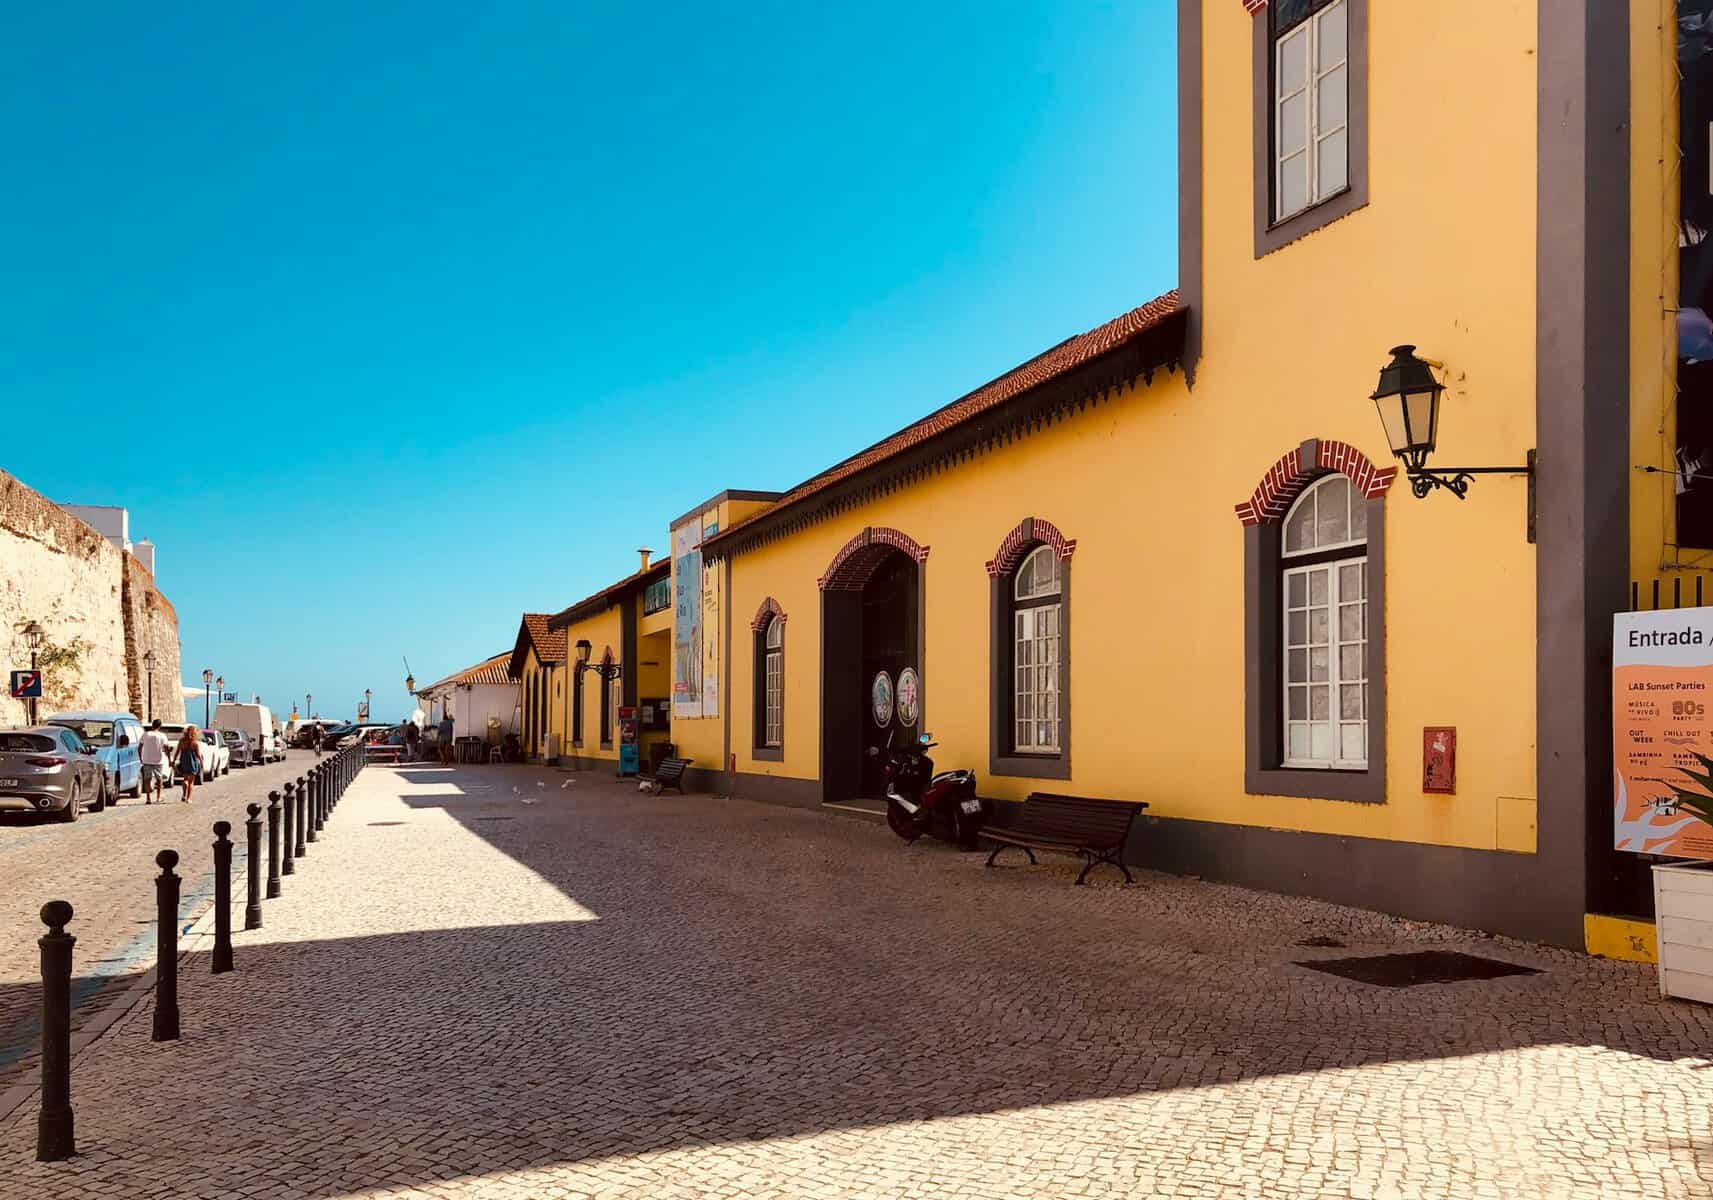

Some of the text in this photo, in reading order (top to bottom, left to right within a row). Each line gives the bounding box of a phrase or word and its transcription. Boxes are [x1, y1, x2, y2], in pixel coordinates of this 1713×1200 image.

[1628, 626, 1703, 648] Entrada
[1628, 680, 1706, 691] LAB Sunset Parties
[1628, 729, 1645, 737] OUT
[1633, 736, 1655, 744] WEEK
